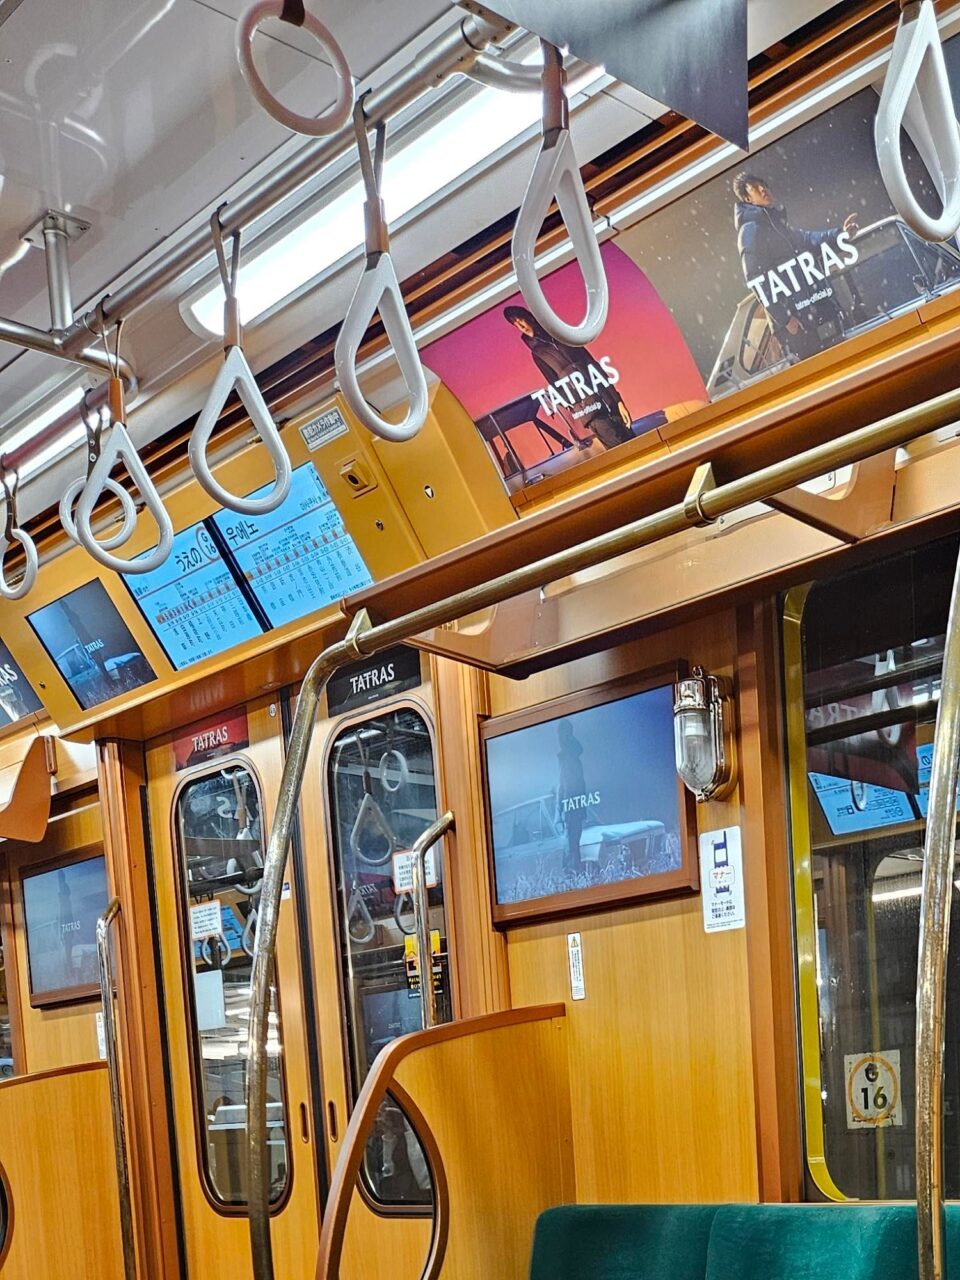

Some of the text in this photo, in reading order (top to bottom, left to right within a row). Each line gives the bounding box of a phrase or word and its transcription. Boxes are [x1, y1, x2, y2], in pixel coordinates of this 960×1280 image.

[747, 232, 859, 309] TATRAS
[531, 356, 620, 417] TATRAS
[201, 532, 208, 542] G
[226, 520, 259, 545] 우에노
[175, 547, 203, 572] うえの
[205, 544, 217, 555] 16
[350, 663, 395, 694] TATRAS
[192, 725, 228, 752] TATRAS
[561, 791, 601, 812] TATRAS
[861, 1086, 888, 1110] 16
